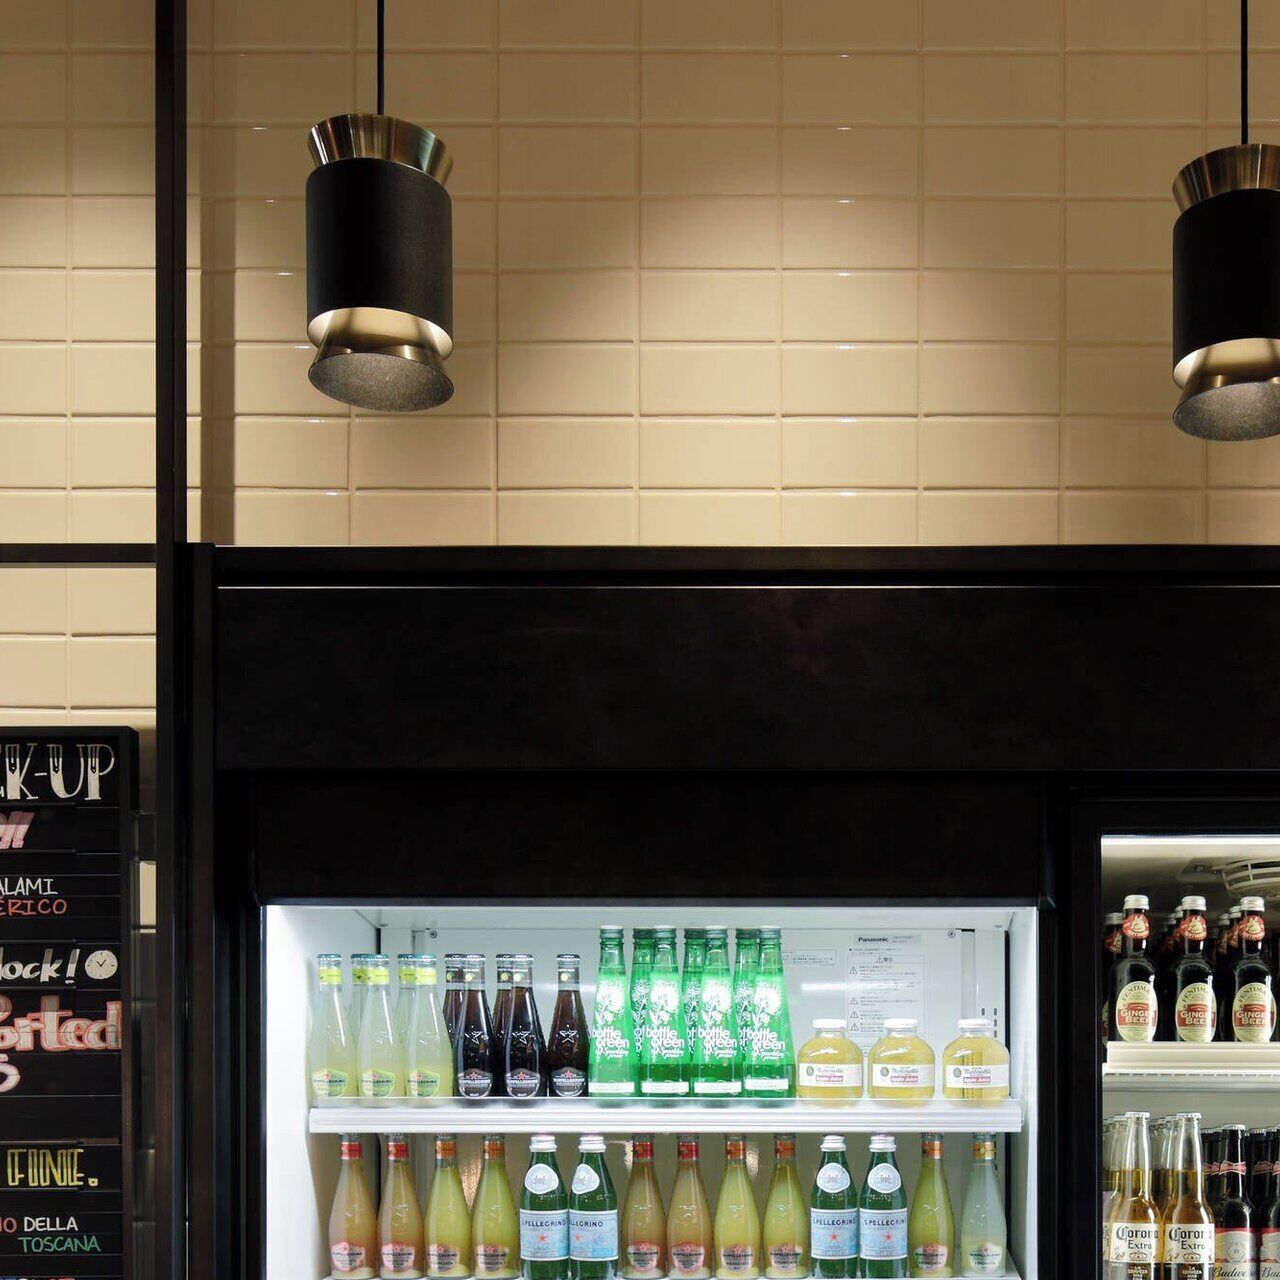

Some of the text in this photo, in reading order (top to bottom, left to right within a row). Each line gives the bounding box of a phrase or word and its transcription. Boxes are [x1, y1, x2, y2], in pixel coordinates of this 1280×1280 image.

[7, 1148, 99, 1188] FINE.
[23, 1216, 78, 1232] DELLA
[18, 1236, 101, 1253] TOSCANA
